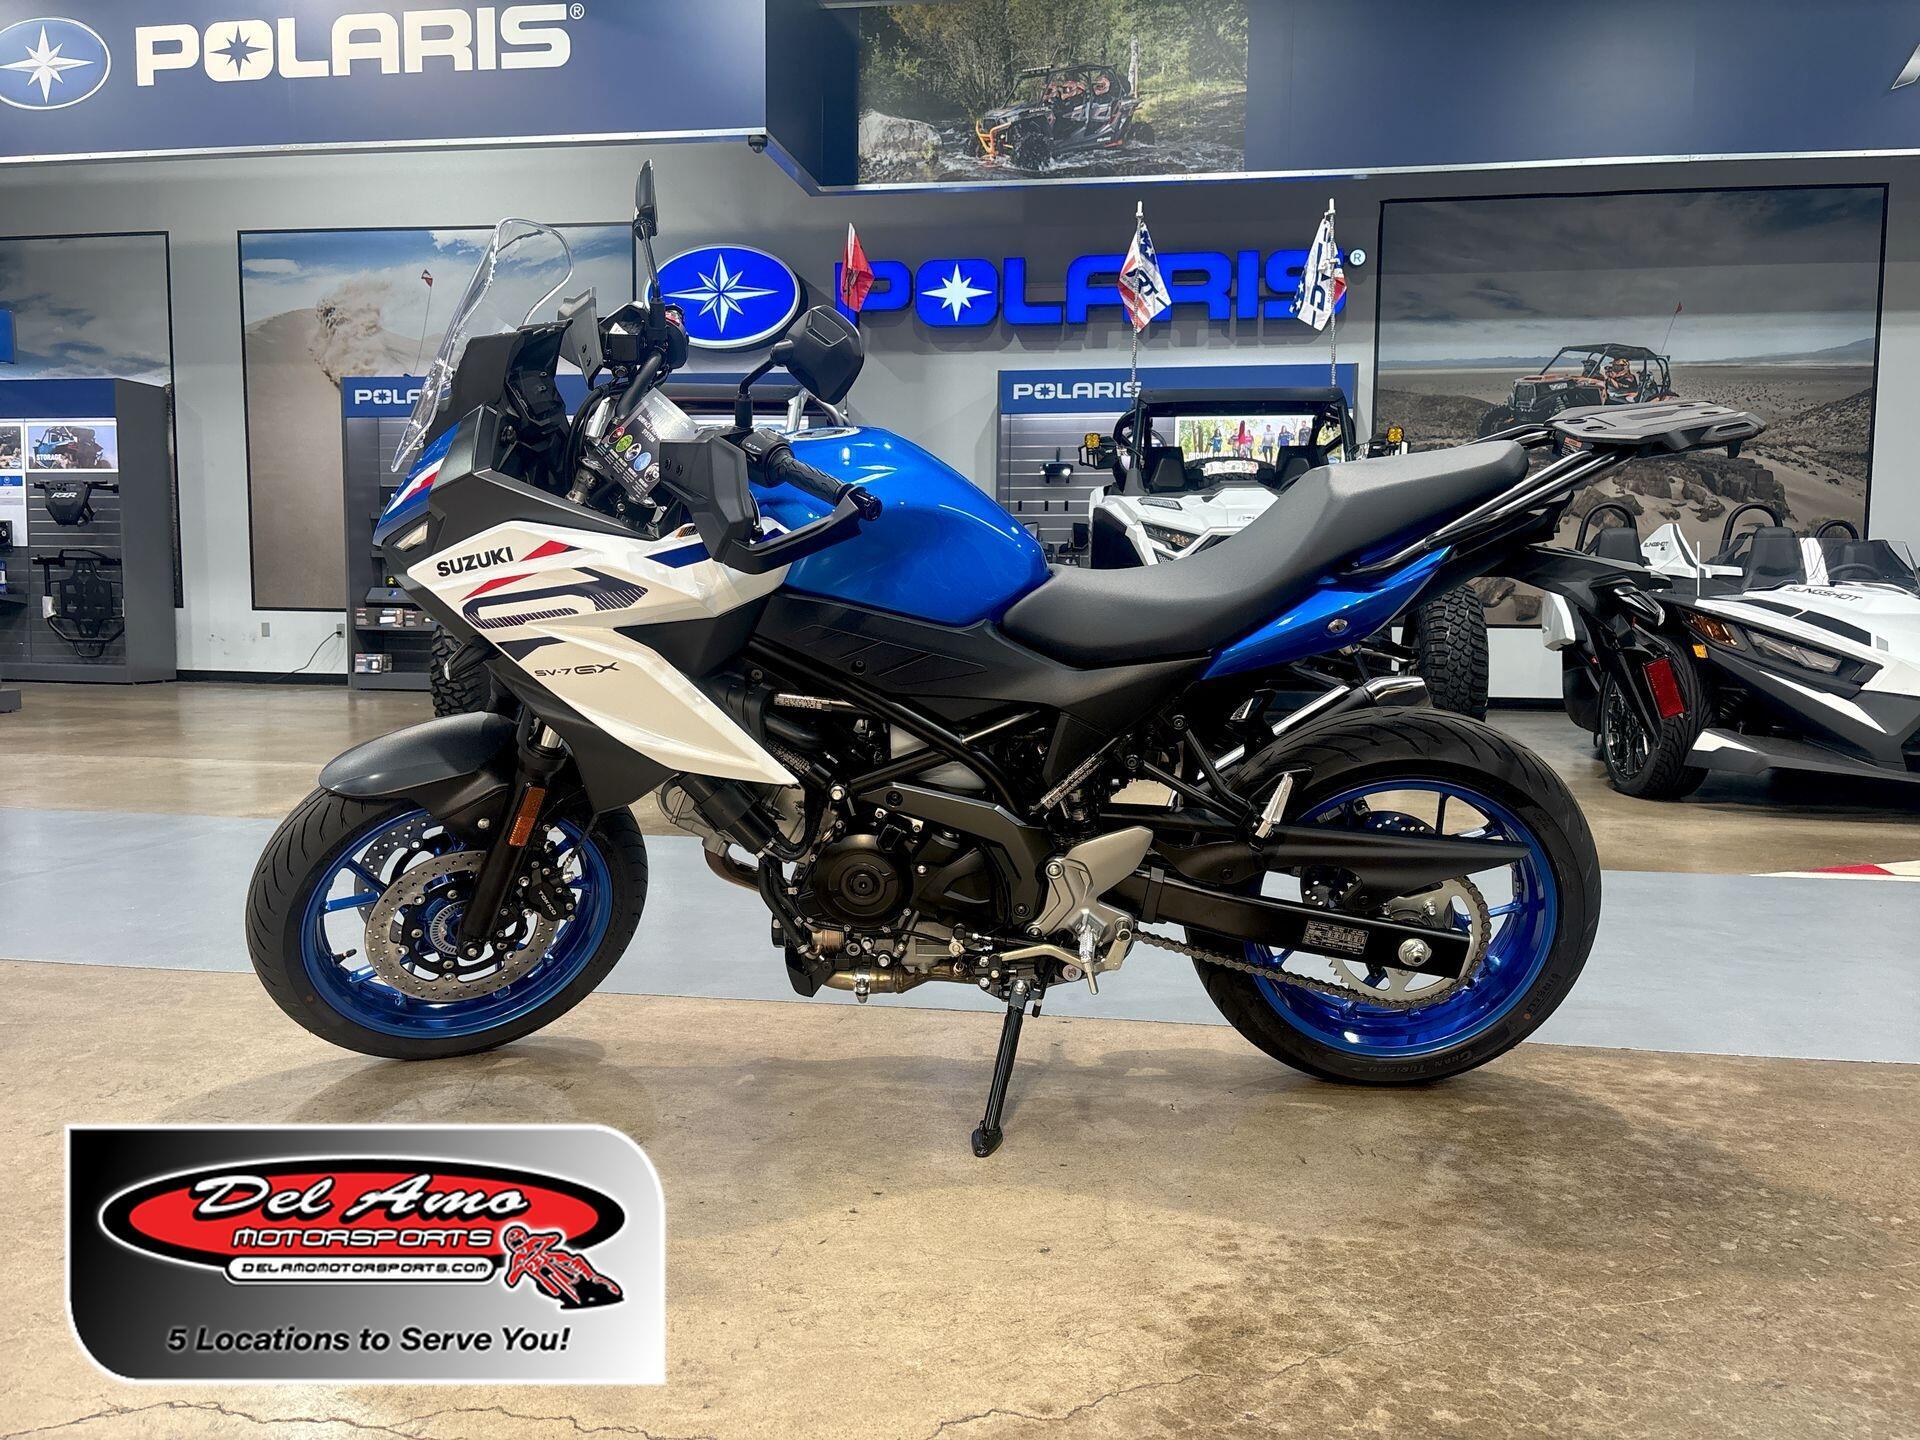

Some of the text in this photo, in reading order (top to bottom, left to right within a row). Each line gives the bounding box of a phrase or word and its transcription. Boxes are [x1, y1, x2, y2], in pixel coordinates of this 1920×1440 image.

[134, 3, 572, 87] POLARIS
[354, 389, 422, 405] POLA
[1013, 381, 1142, 400] POLARIS
[51, 491, 77, 499] RZR
[436, 546, 514, 577] SUZUKI
[1785, 586, 1863, 602] SLINGSHOT
[539, 890, 557, 915] TOKICO
